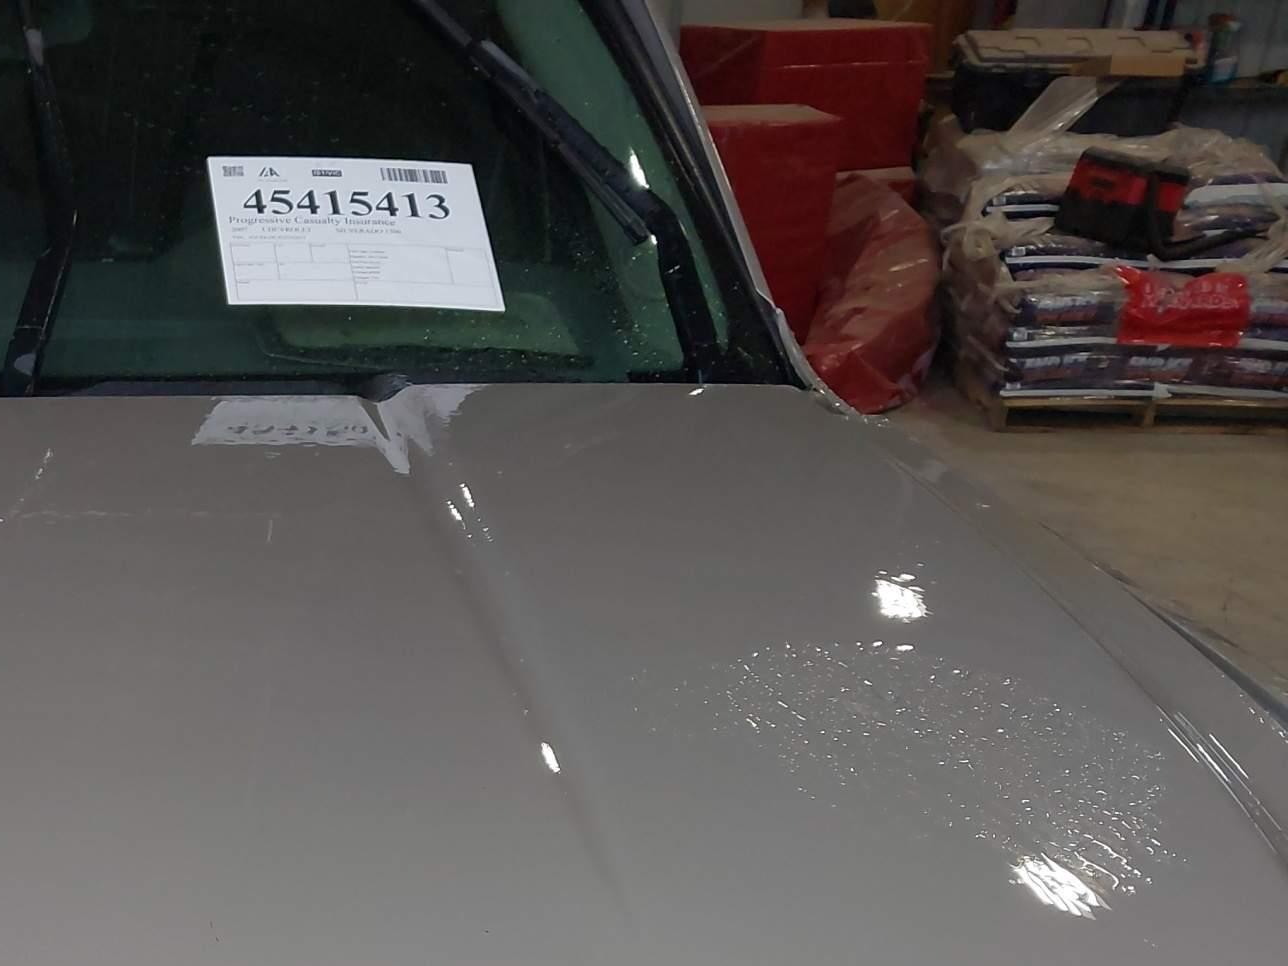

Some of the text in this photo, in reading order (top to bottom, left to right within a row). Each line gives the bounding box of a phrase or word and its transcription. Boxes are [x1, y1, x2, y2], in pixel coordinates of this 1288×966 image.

[243, 188, 451, 220] 45415413
[228, 215, 396, 226] Progressive Casualty Insurance
